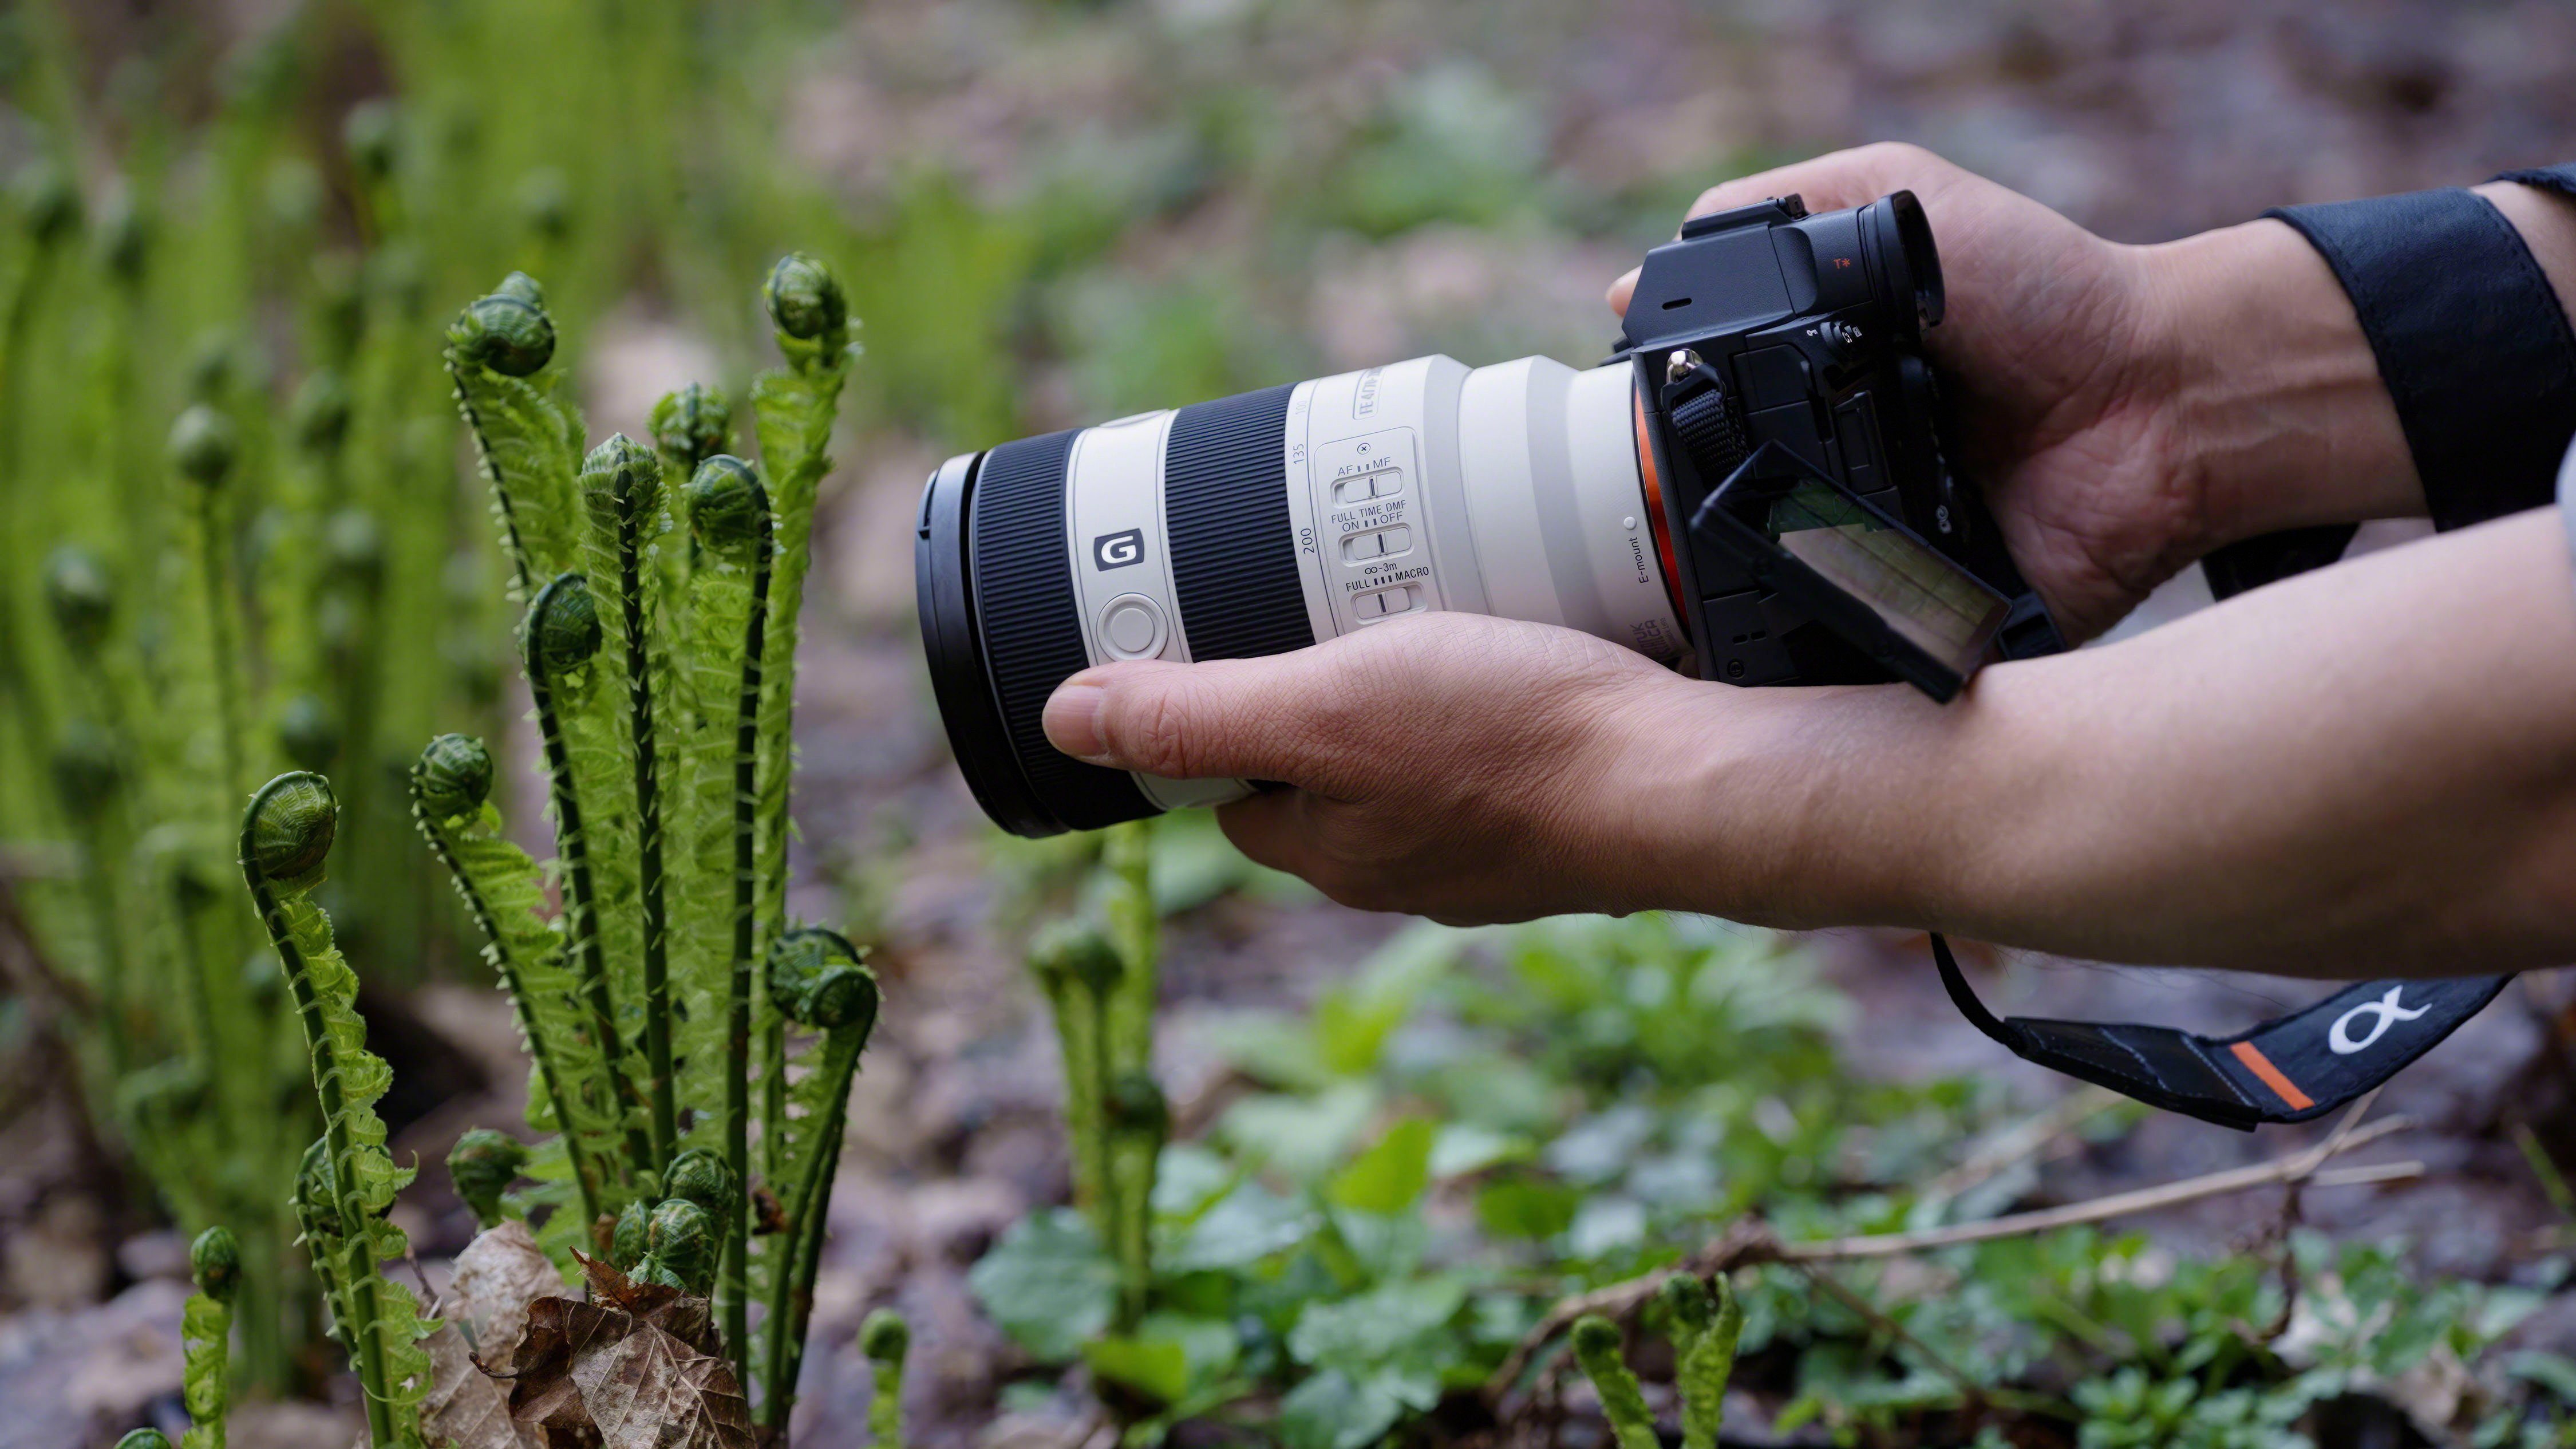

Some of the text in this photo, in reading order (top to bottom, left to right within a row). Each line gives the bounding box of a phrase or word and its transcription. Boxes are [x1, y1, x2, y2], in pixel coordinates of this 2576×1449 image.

[1293, 444, 1305, 465] 135
[1337, 456, 1391, 477] AF MF
[1331, 499, 1406, 524] FULL TIME DMF
[1342, 511, 1403, 532] ON OFF
[1101, 535, 1137, 564] G
[1301, 528, 1315, 555] 200
[1628, 536, 1649, 583] E-mount
[1346, 566, 1429, 592] FULL MACRO
